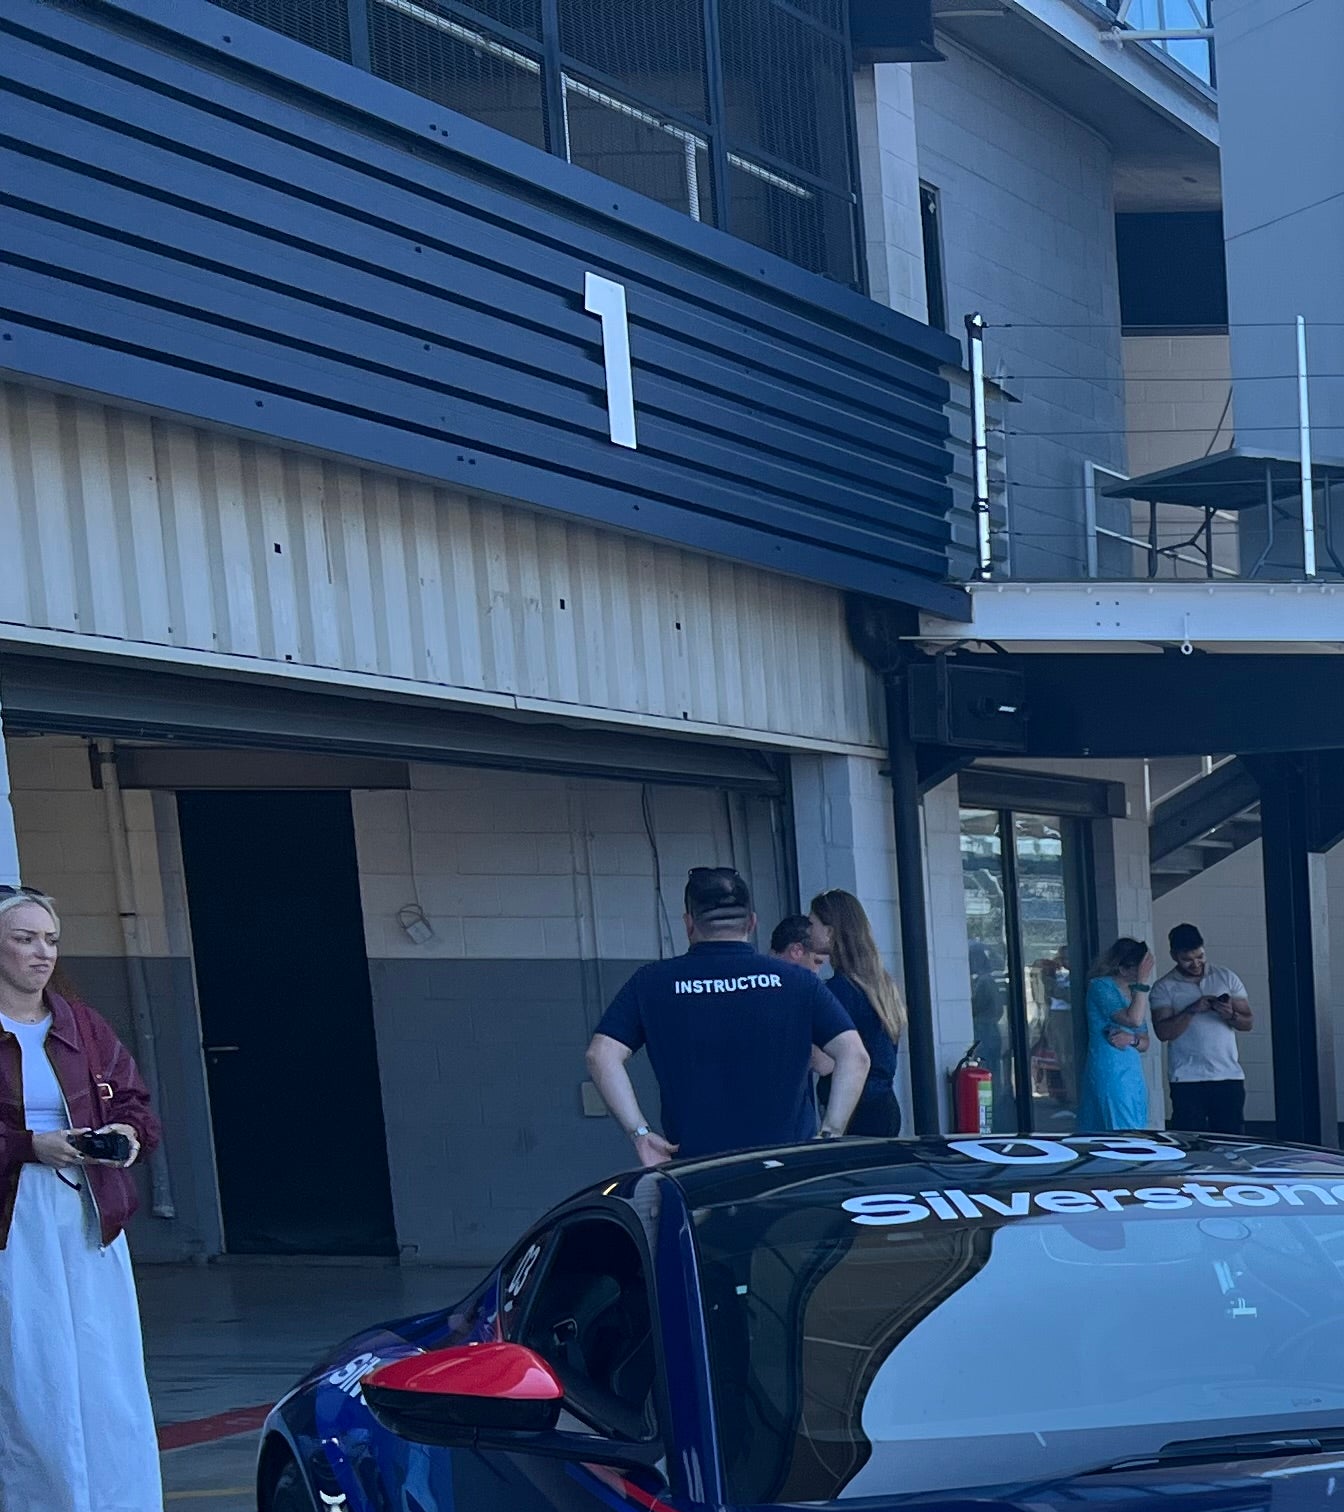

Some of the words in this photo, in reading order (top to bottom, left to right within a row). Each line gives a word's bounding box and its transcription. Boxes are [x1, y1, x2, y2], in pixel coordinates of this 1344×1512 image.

[584, 271, 637, 450] 1
[675, 973, 782, 994] INSTRUCTOR
[946, 1136, 1187, 1165] 03
[508, 1243, 541, 1297] 03
